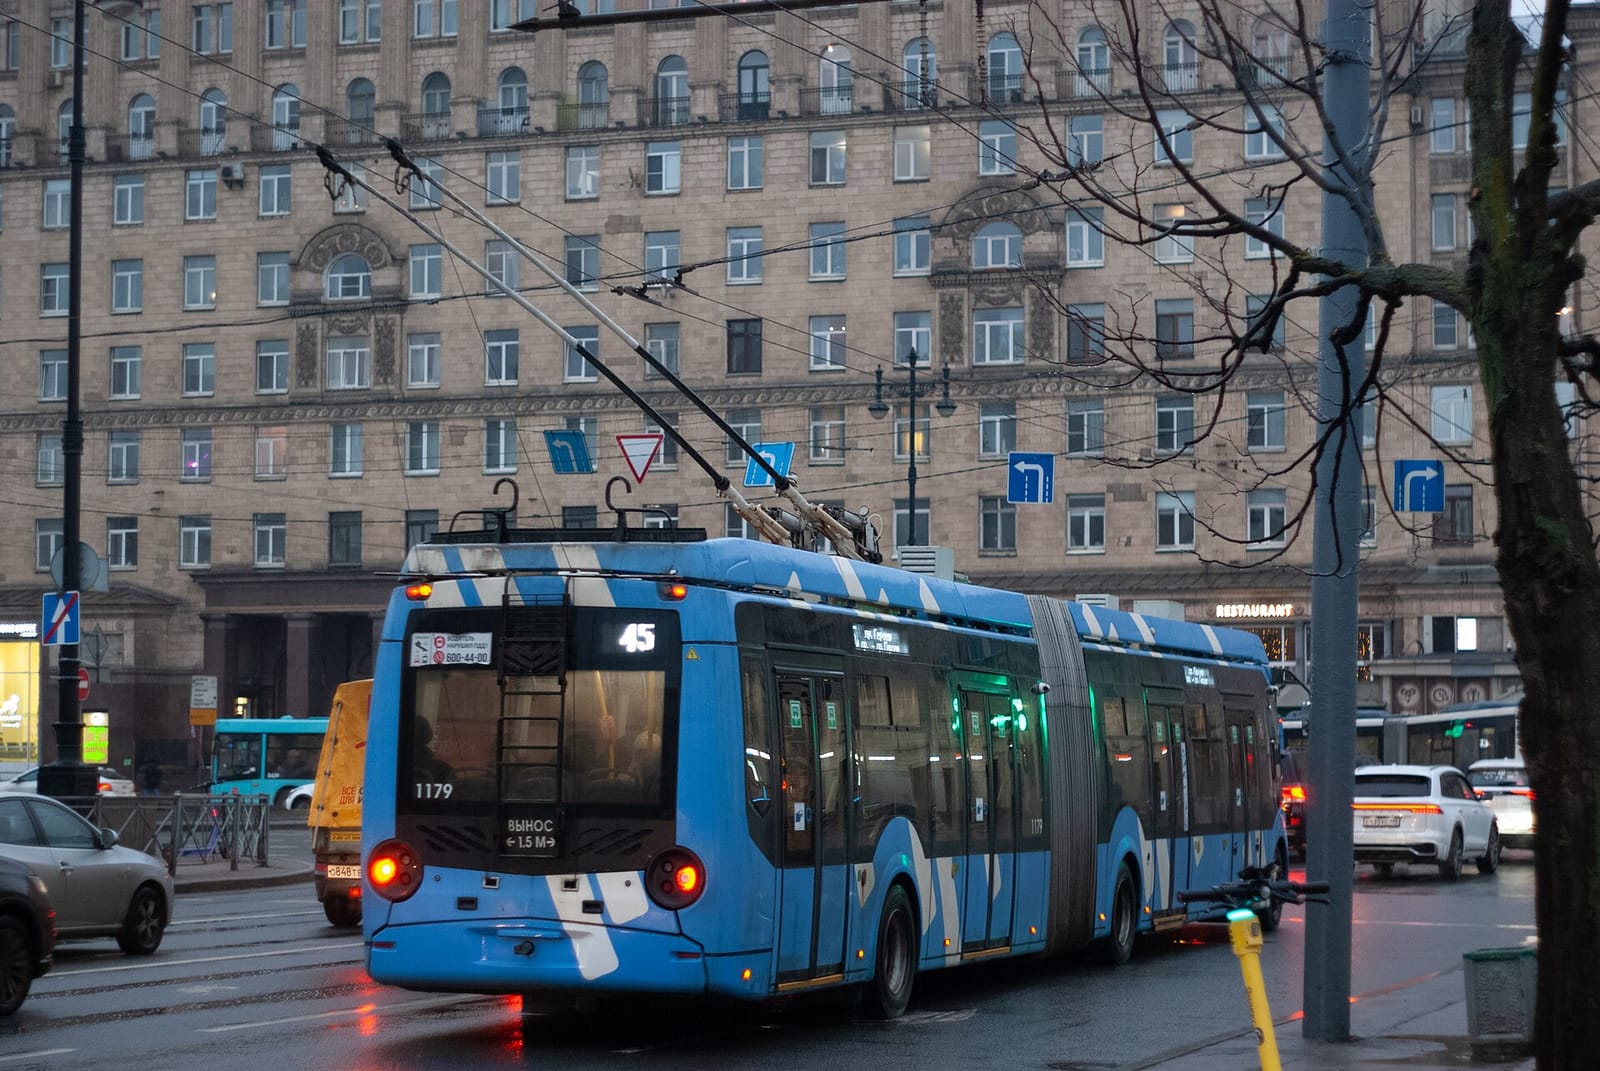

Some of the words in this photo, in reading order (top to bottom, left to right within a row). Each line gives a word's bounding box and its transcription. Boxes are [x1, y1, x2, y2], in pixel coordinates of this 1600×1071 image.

[1216, 604, 1292, 617] RESTAURANT
[619, 623, 655, 652] 45
[447, 653, 487, 662] 600-44-00
[416, 783, 453, 799] 1179
[508, 820, 553, 832] ВЫНОС
